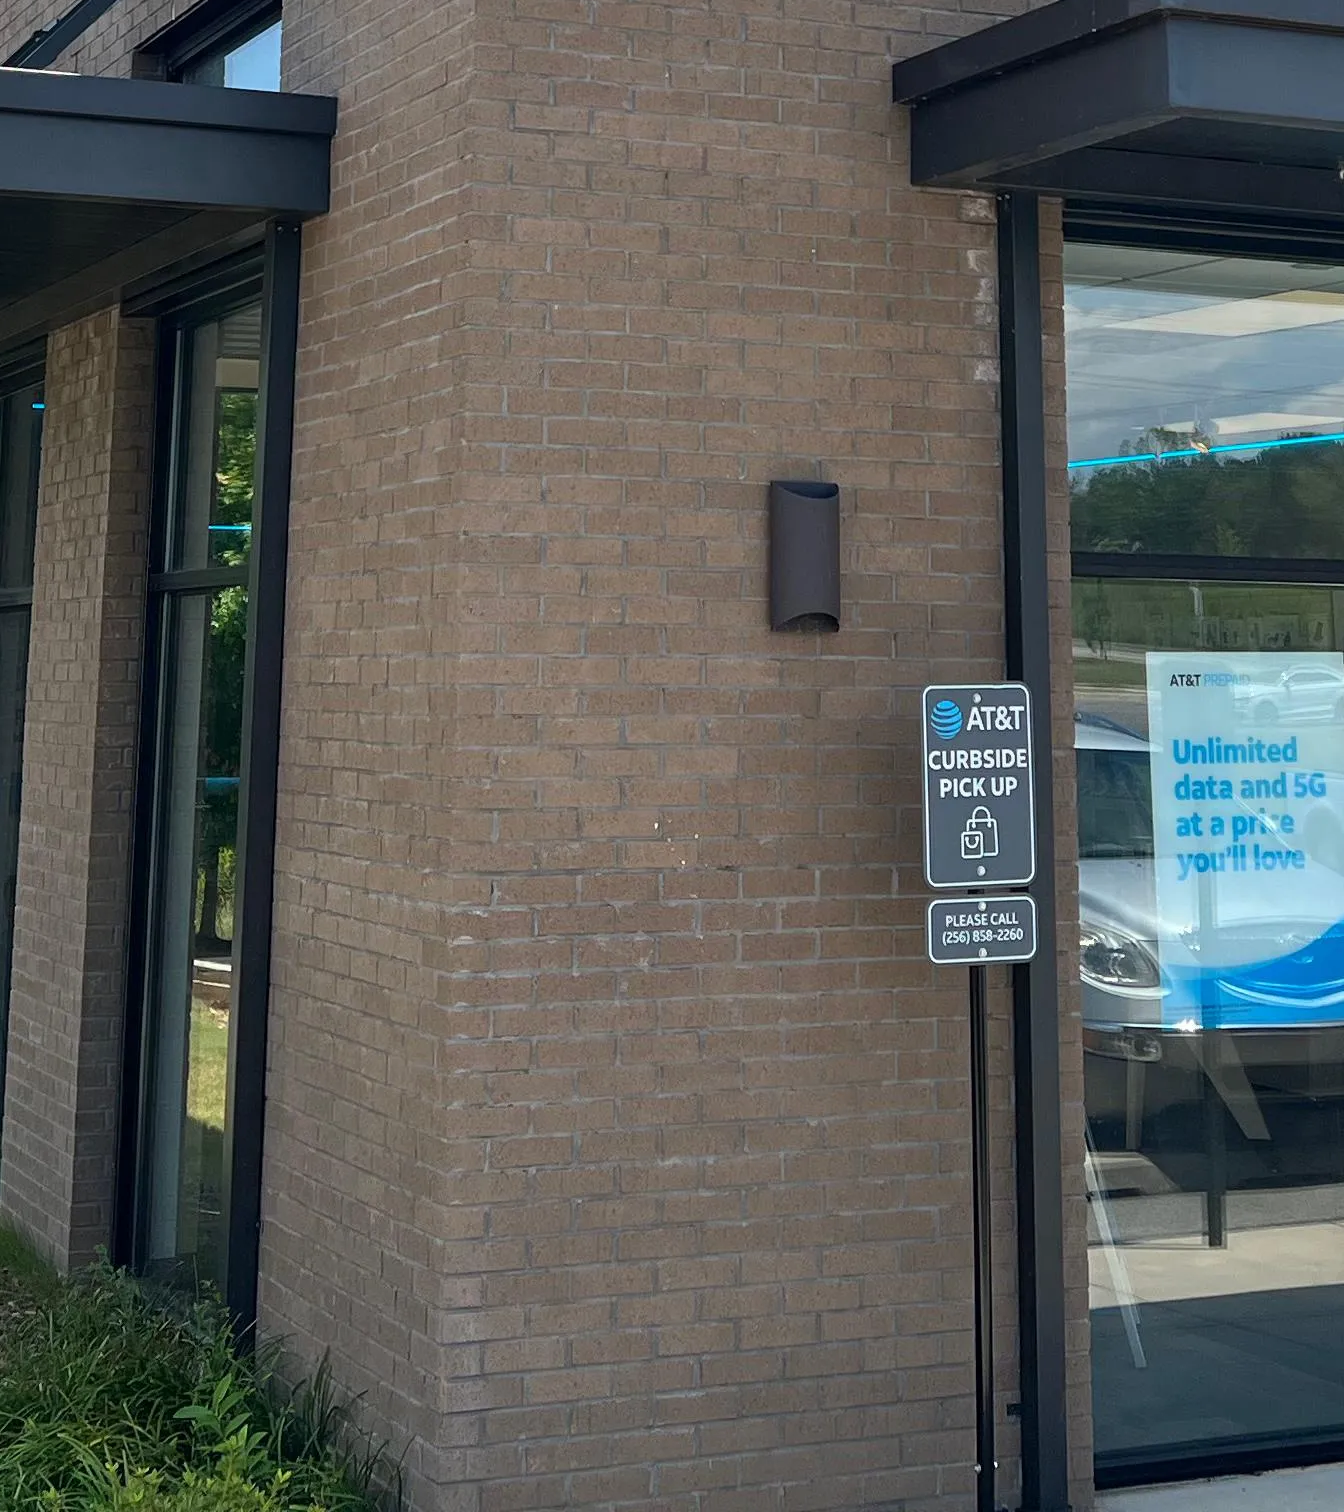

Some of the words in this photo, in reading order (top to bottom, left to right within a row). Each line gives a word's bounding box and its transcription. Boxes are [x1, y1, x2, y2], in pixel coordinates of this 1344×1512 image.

[1170, 674, 1201, 686] AT&T
[966, 705, 1024, 731] AT&T
[928, 749, 1028, 770] CURBSIDE
[1173, 736, 1298, 764] Unlimited
[939, 777, 987, 798] PICK
[991, 776, 1018, 796] UP
[1174, 774, 1233, 800] data
[1240, 772, 1287, 799] and
[1294, 772, 1327, 798] 5G
[1176, 812, 1203, 837] at
[1210, 815, 1224, 836] a
[1232, 807, 1295, 842] prie
[1177, 845, 1246, 881] you'll
[1254, 844, 1305, 870] love
[945, 914, 989, 927] PLEASE
[990, 912, 1019, 925] CALL
[942, 930, 970, 946] (256)
[972, 928, 1024, 942] 858-2260
